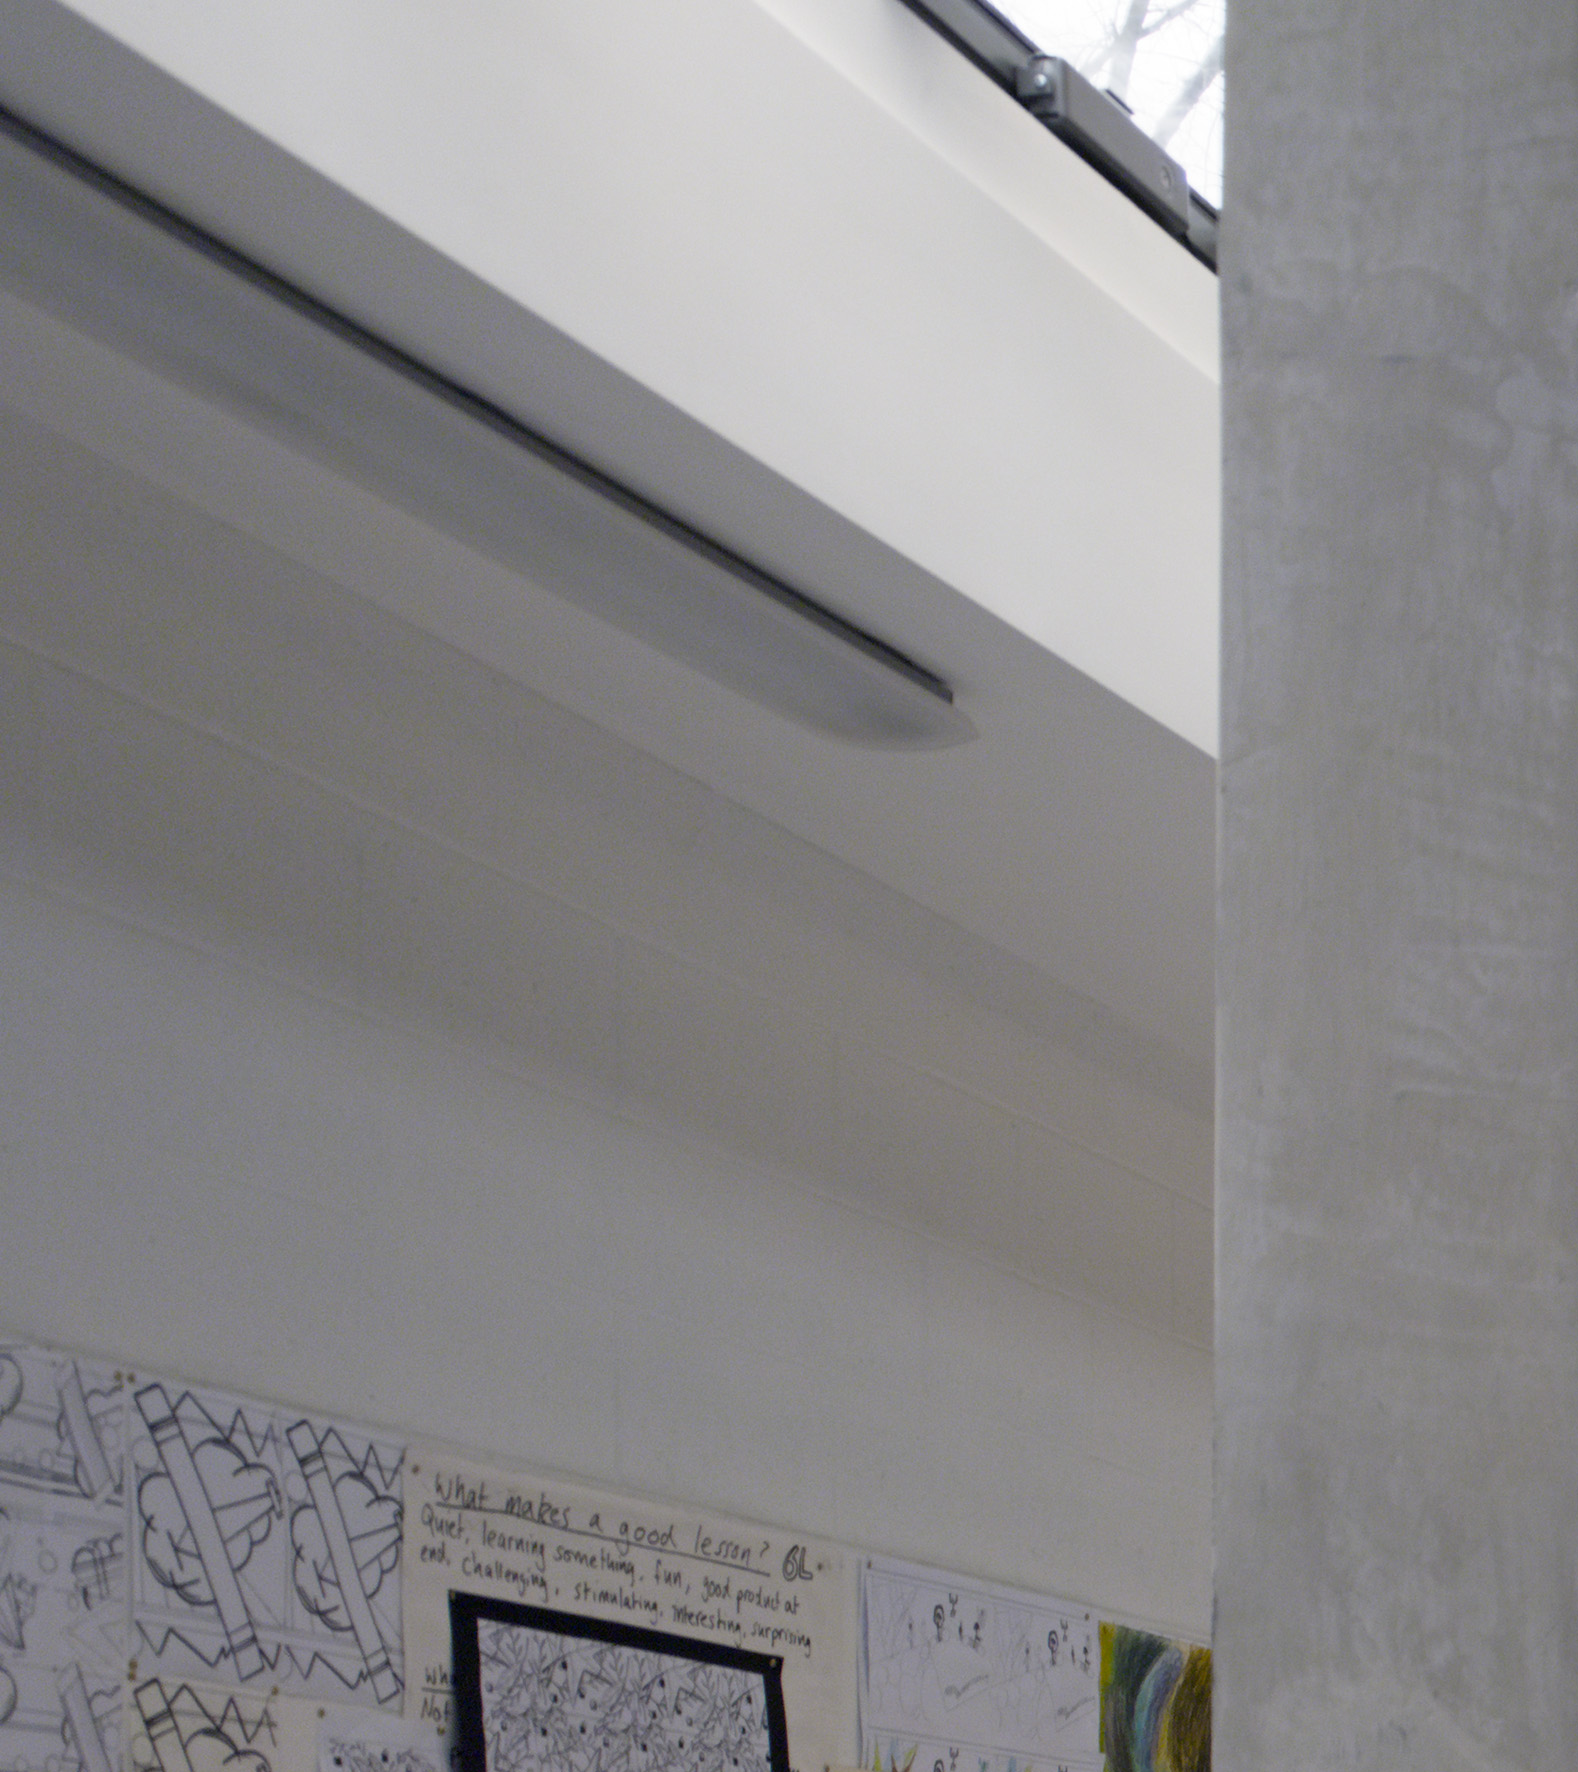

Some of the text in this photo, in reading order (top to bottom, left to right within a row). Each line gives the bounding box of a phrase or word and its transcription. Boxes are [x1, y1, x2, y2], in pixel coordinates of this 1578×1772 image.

[434, 1472, 488, 1510] What
[504, 1492, 570, 1530] makes
[588, 1513, 604, 1532] a
[619, 1521, 677, 1556] good
[482, 1519, 546, 1573] learning
[702, 1575, 730, 1603] good
[736, 1585, 782, 1614] product
[784, 1595, 800, 1616] at
[750, 1621, 812, 1659] surprising
